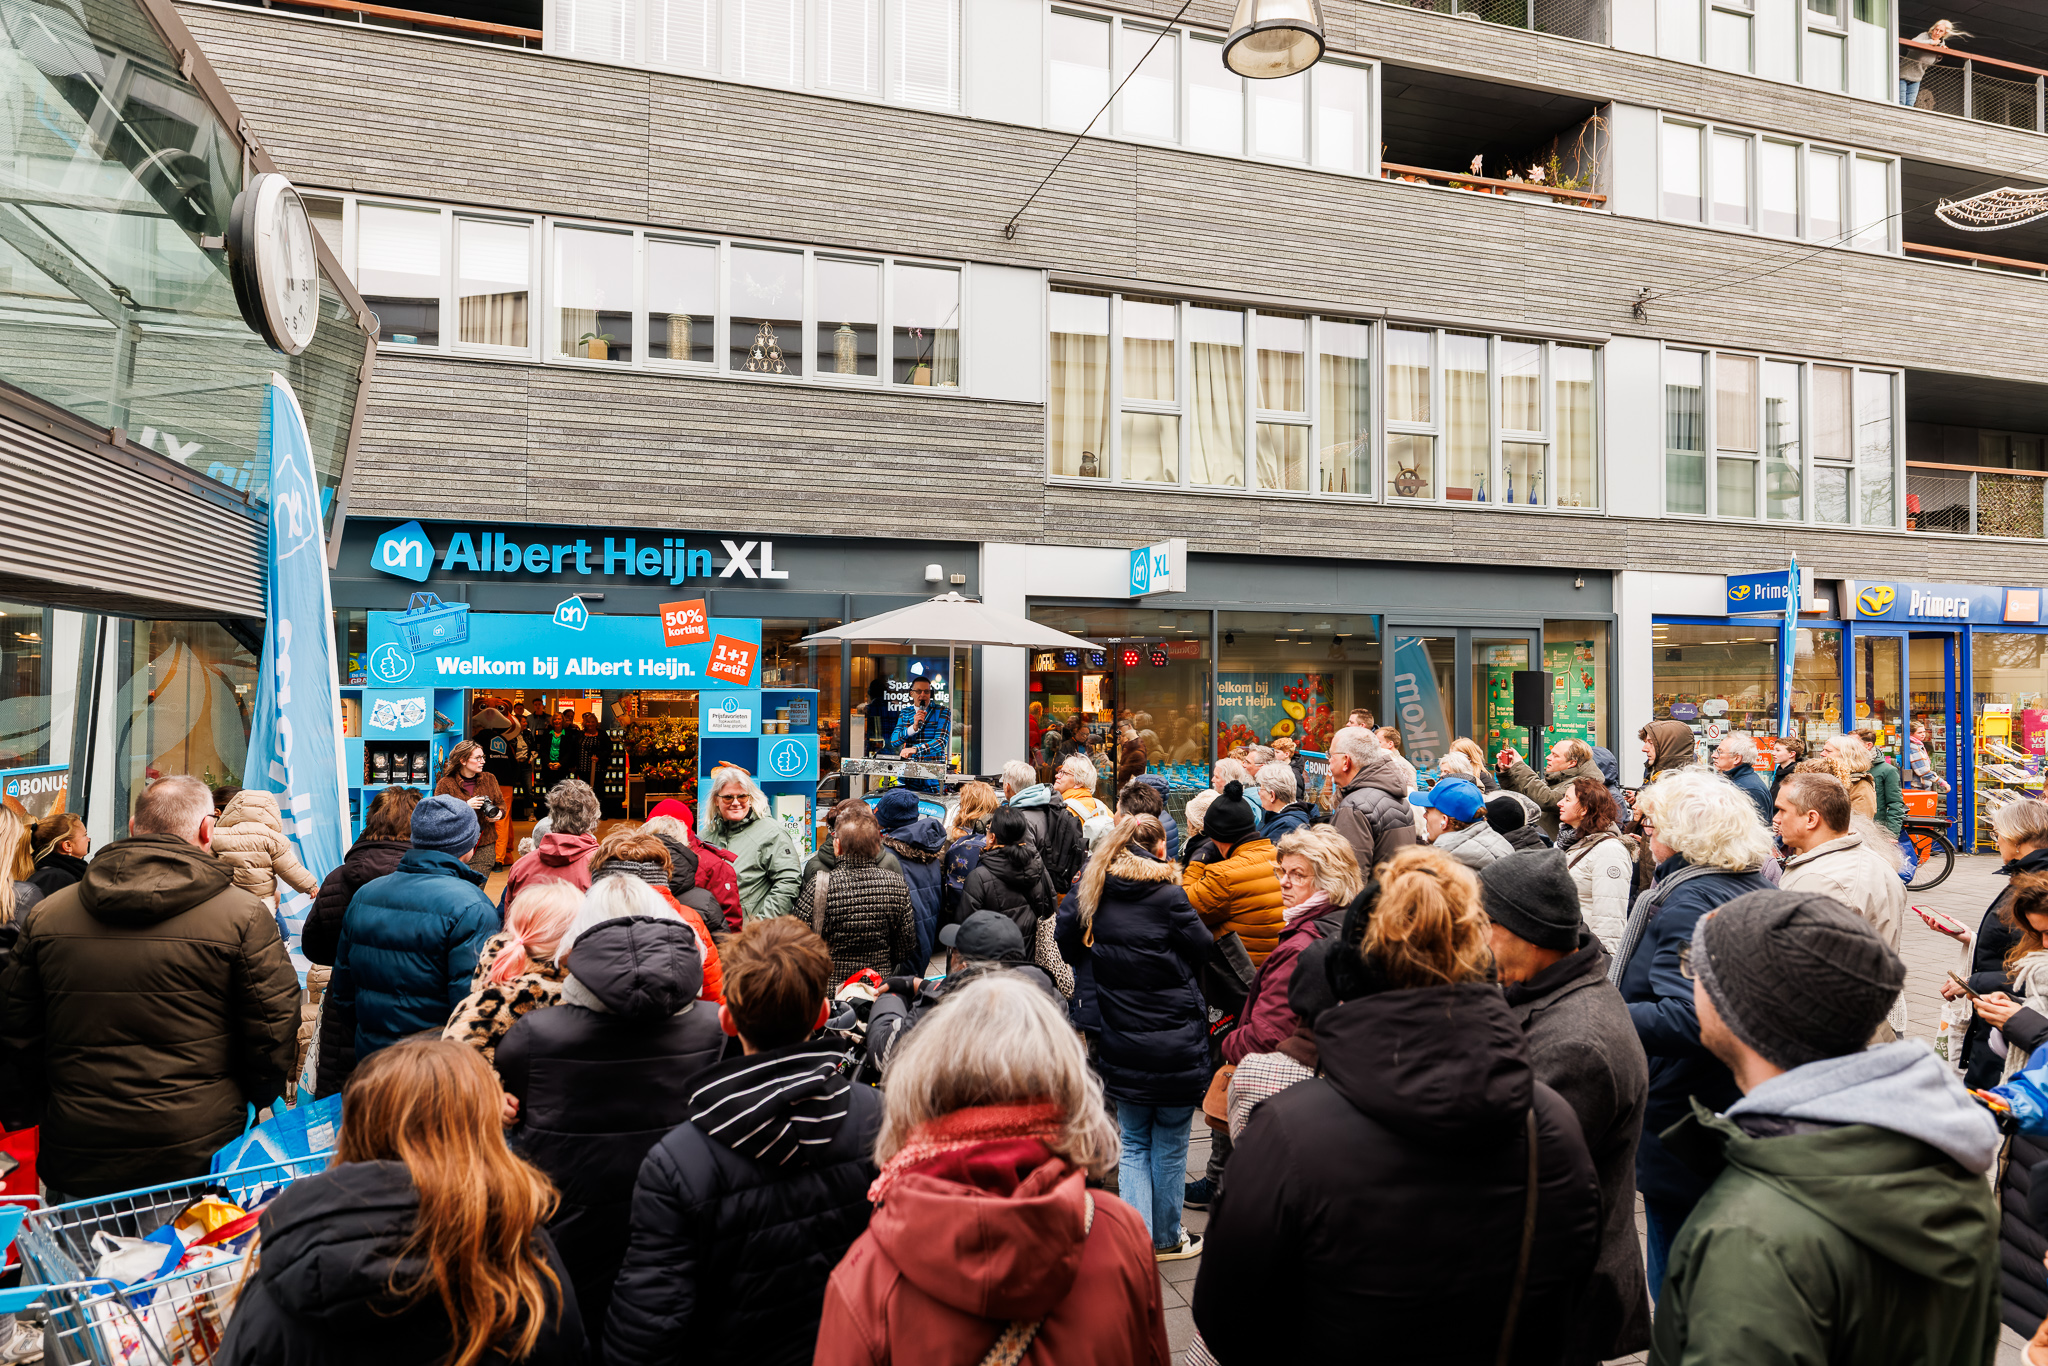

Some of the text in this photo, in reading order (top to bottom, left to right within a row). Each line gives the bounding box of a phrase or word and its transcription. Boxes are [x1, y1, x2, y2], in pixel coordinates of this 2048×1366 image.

[441, 532, 789, 586] Albert Heijn XL
[1153, 553, 1170, 578] XL
[1754, 583, 1801, 600] Primea
[1908, 589, 1970, 618] Primera
[665, 609, 704, 627] 50%
[667, 623, 705, 637] korting
[714, 645, 749, 667] 1+1
[435, 655, 696, 680] Welkom bij Albert Heijn.
[711, 661, 747, 678] gratis
[1255, 681, 1269, 696] bij
[1216, 694, 1277, 709] lbert Heijn.
[2031, 736, 2046, 744] VO
[1309, 761, 1333, 777] BONUS
[19, 773, 69, 796] BONUS
